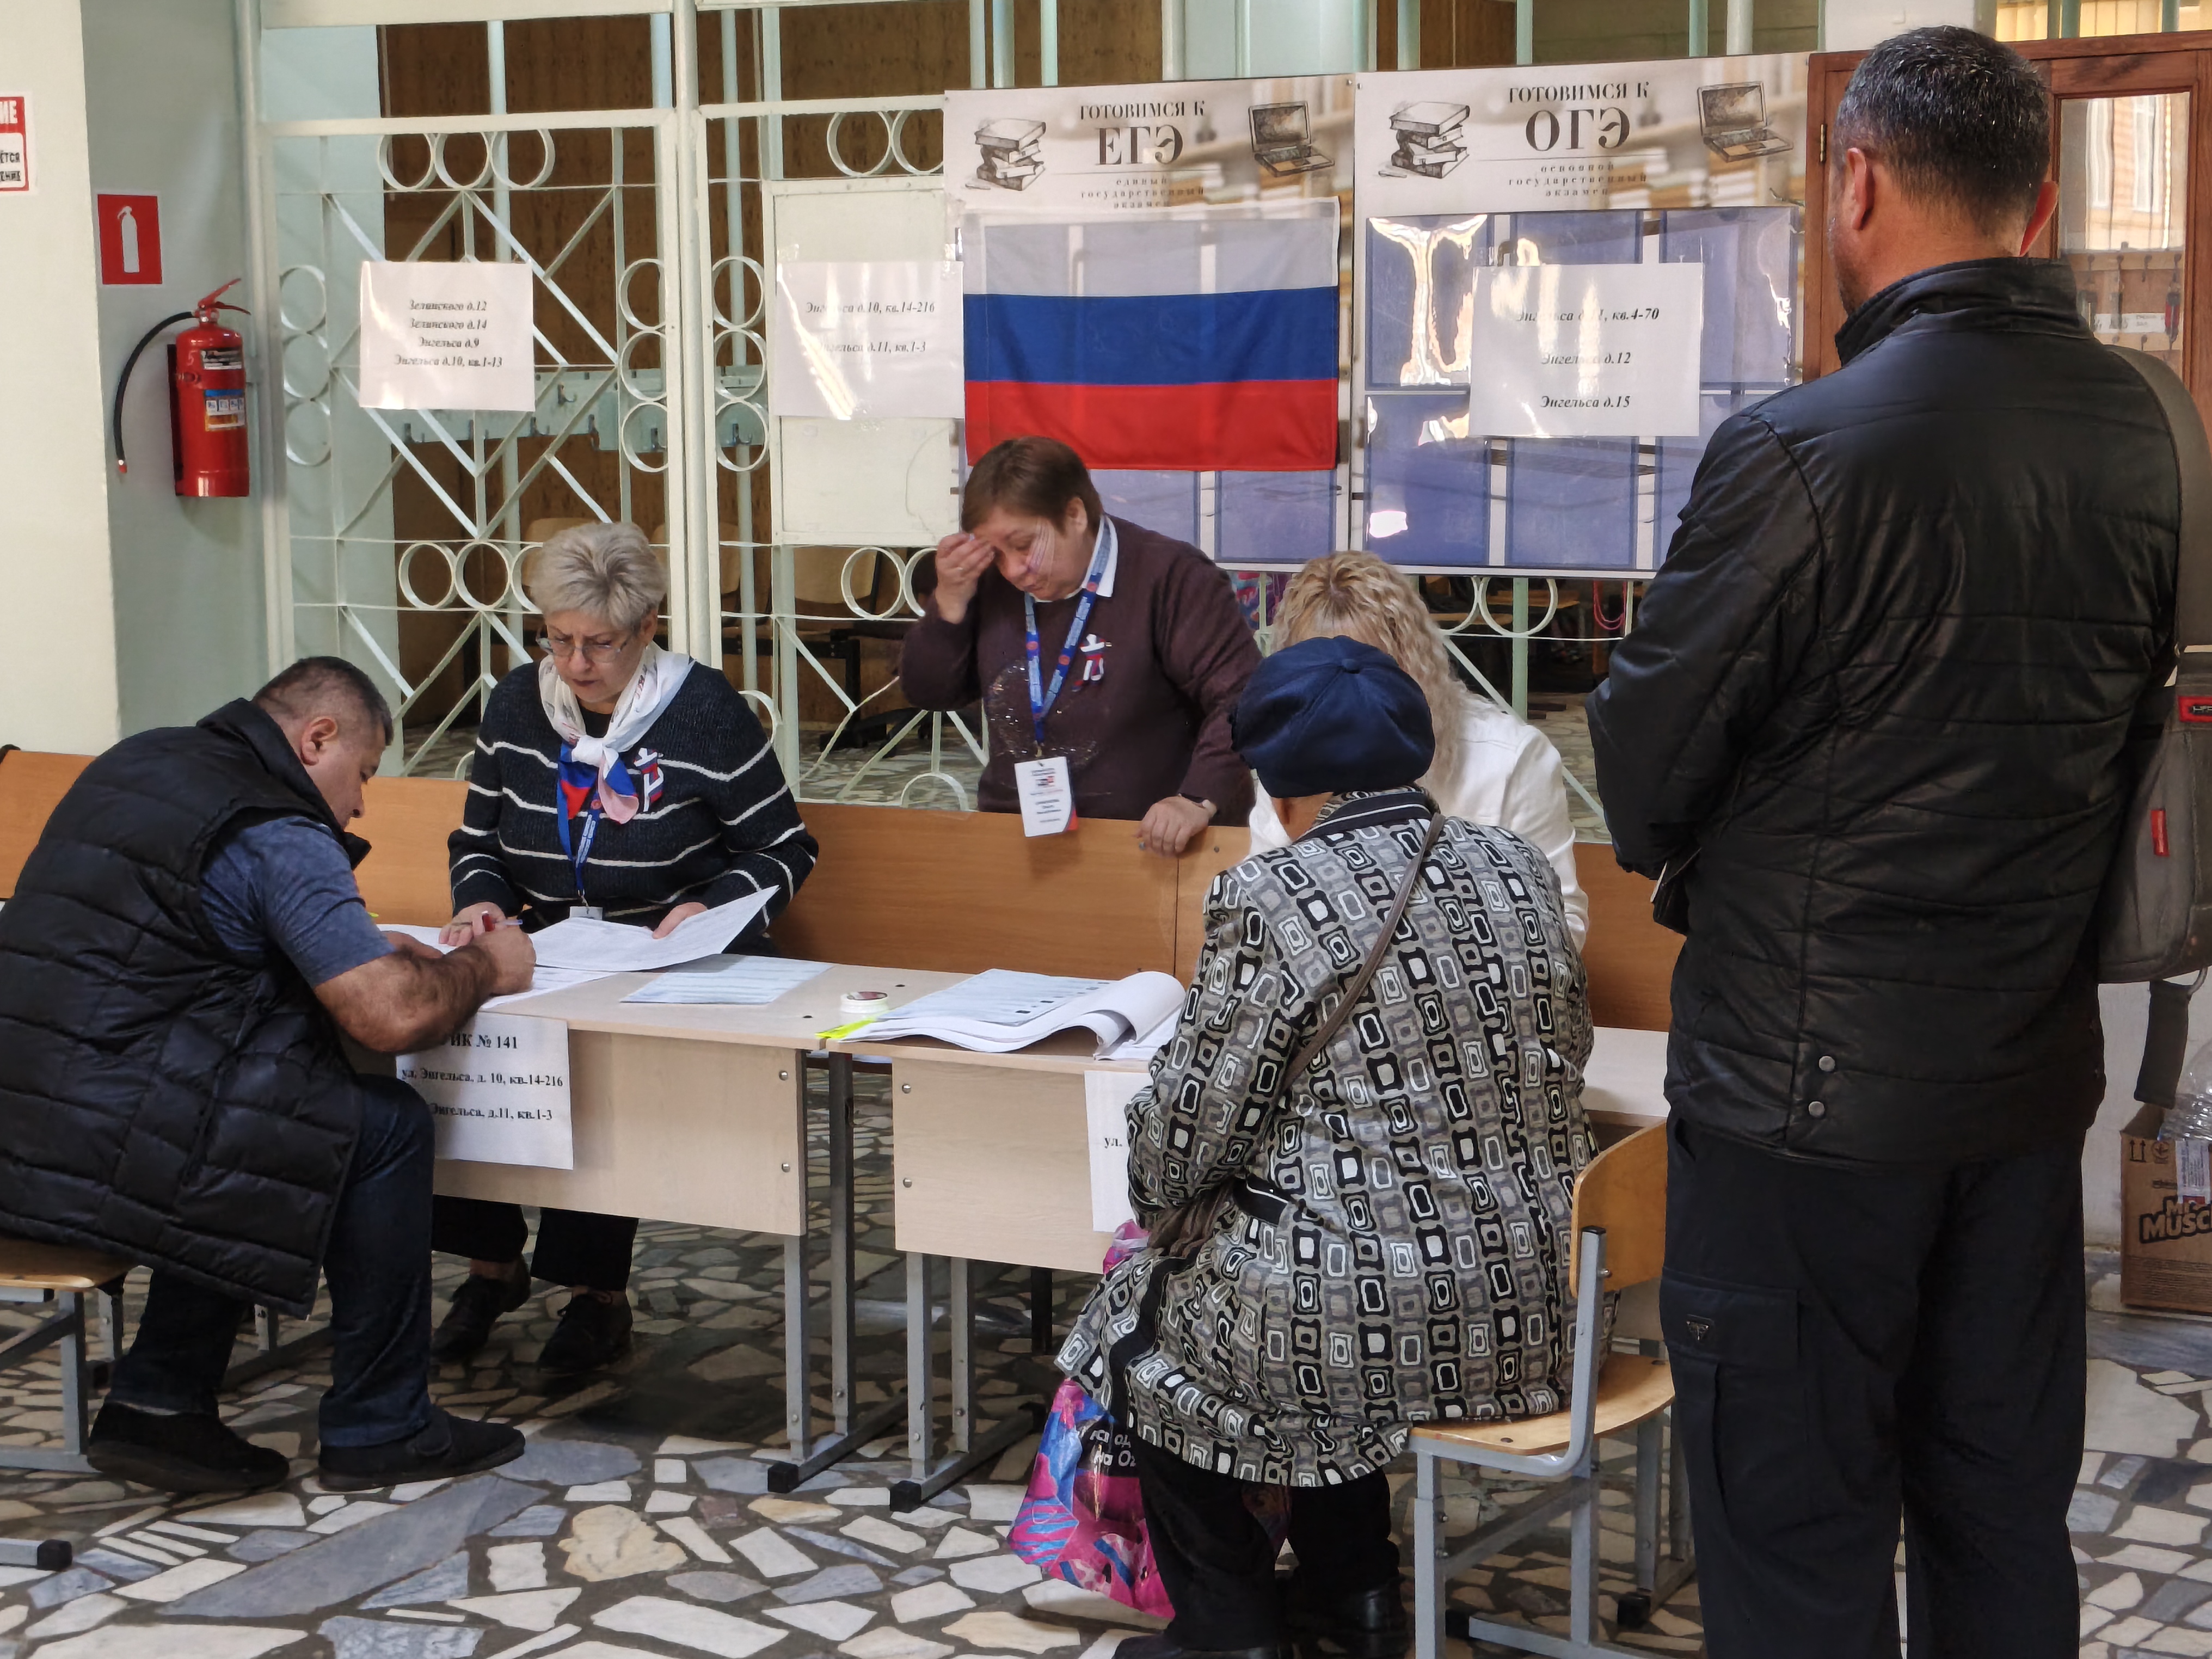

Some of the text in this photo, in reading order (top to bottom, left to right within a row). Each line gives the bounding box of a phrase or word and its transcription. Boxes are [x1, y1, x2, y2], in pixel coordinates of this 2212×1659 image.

[1509, 81, 1650, 103] ГОТОВИМСЯ К
[1080, 100, 1205, 120] ГОТОВИМСЯ К
[1525, 107, 1630, 152] ОГЭ
[1095, 124, 1184, 165] ЕГЭ
[1509, 172, 1647, 187] государственный
[1081, 186, 1204, 200] государственный
[1612, 308, 1660, 321] кв.4-70
[1604, 352, 1631, 364] д.12
[1540, 396, 1631, 408] Энгельса д.15
[450, 1033, 472, 1047] ИК
[496, 1035, 518, 1049] 141
[1104, 1137, 1123, 1149] ул.
[2142, 1209, 2212, 1240] MUSC
